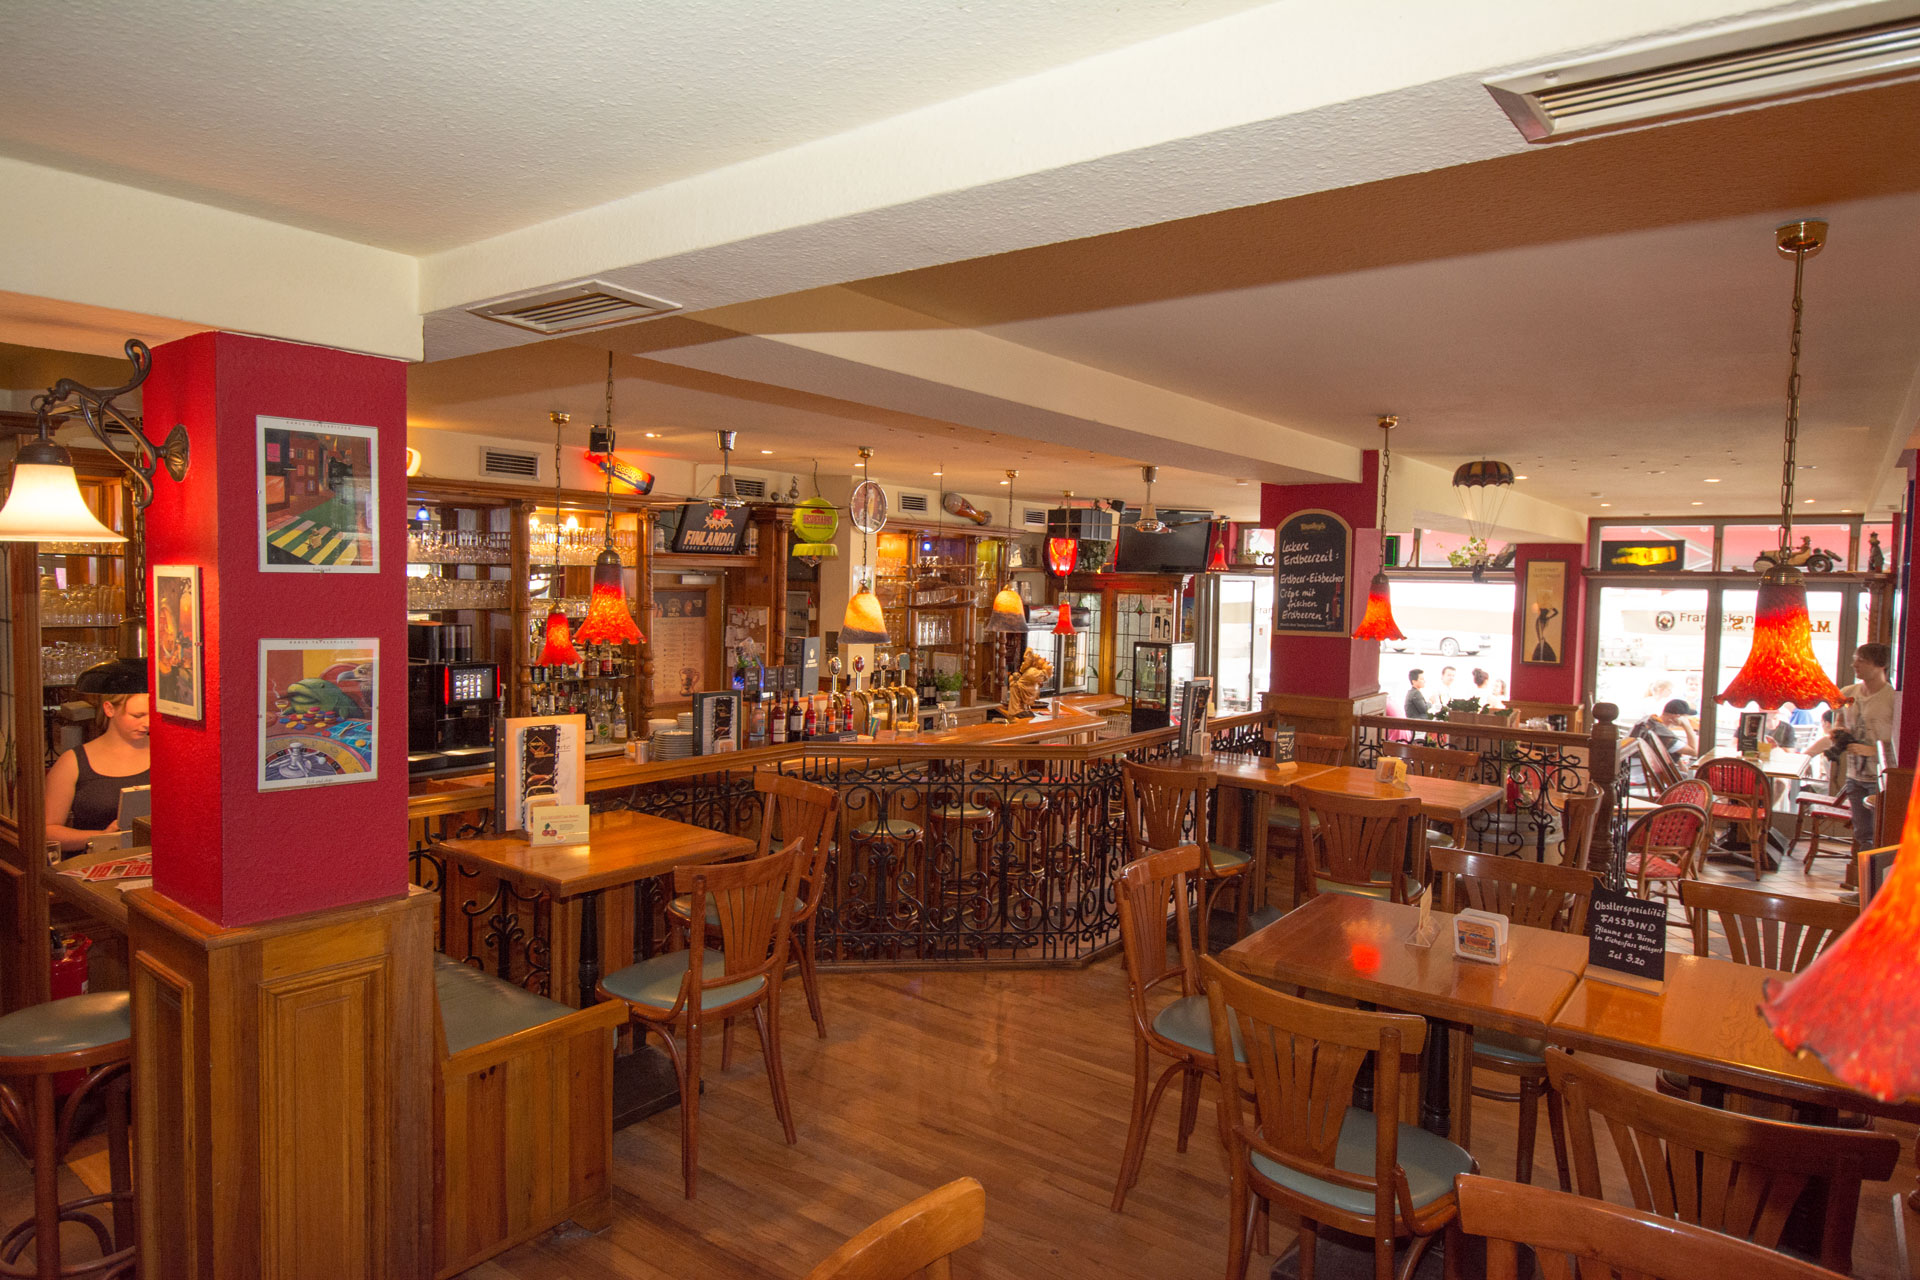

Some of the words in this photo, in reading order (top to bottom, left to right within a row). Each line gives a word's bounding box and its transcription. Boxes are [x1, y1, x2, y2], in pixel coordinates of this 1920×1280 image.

[683, 530, 737, 546] FINLANDIA
[1282, 540, 1310, 553] Leckere
[1301, 588, 1316, 597] mit
[1287, 600, 1318, 611] frischen
[1594, 900, 1666, 918] Obstlerspezialität
[1600, 914, 1656, 932] FASSBIND
[1594, 924, 1621, 937] Pflaume
[1636, 933, 1657, 945] Birne
